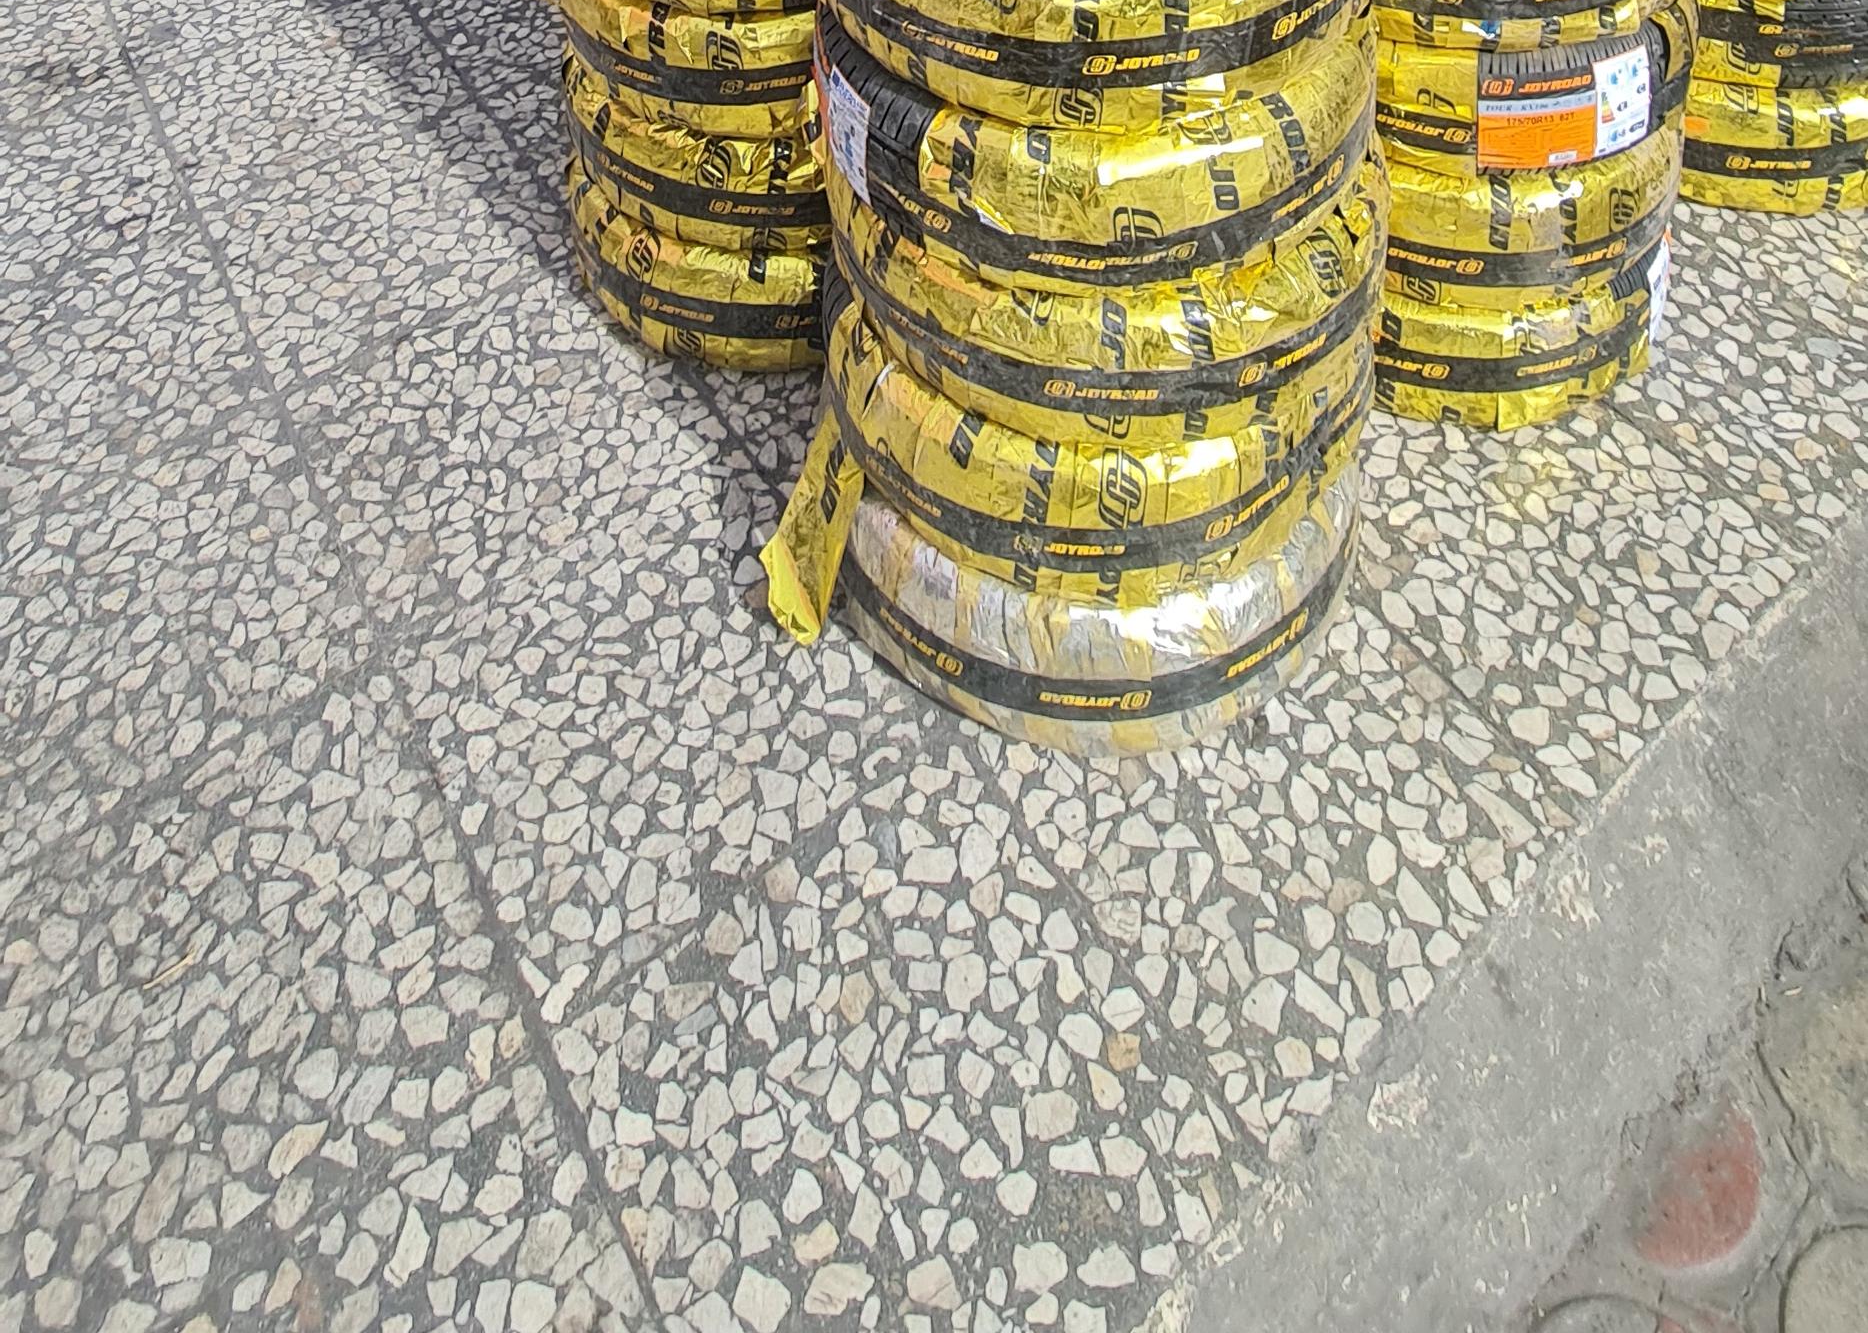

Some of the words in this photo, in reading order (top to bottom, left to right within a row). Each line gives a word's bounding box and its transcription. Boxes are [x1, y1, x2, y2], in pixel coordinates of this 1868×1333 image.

[925, 35, 999, 63] JOYROAD
[1115, 49, 1200, 71] JOYROAD
[1518, 75, 1592, 93] JOYROAD
[1376, 114, 1445, 137] JOYROAD
[1506, 115, 1555, 127] 175/70R13
[1388, 247, 1456, 269] JOYROAD
[1074, 387, 1160, 402] JOYROAD
[1226, 628, 1293, 679] JOYROAD
[1039, 691, 1120, 709] JOYROAD
